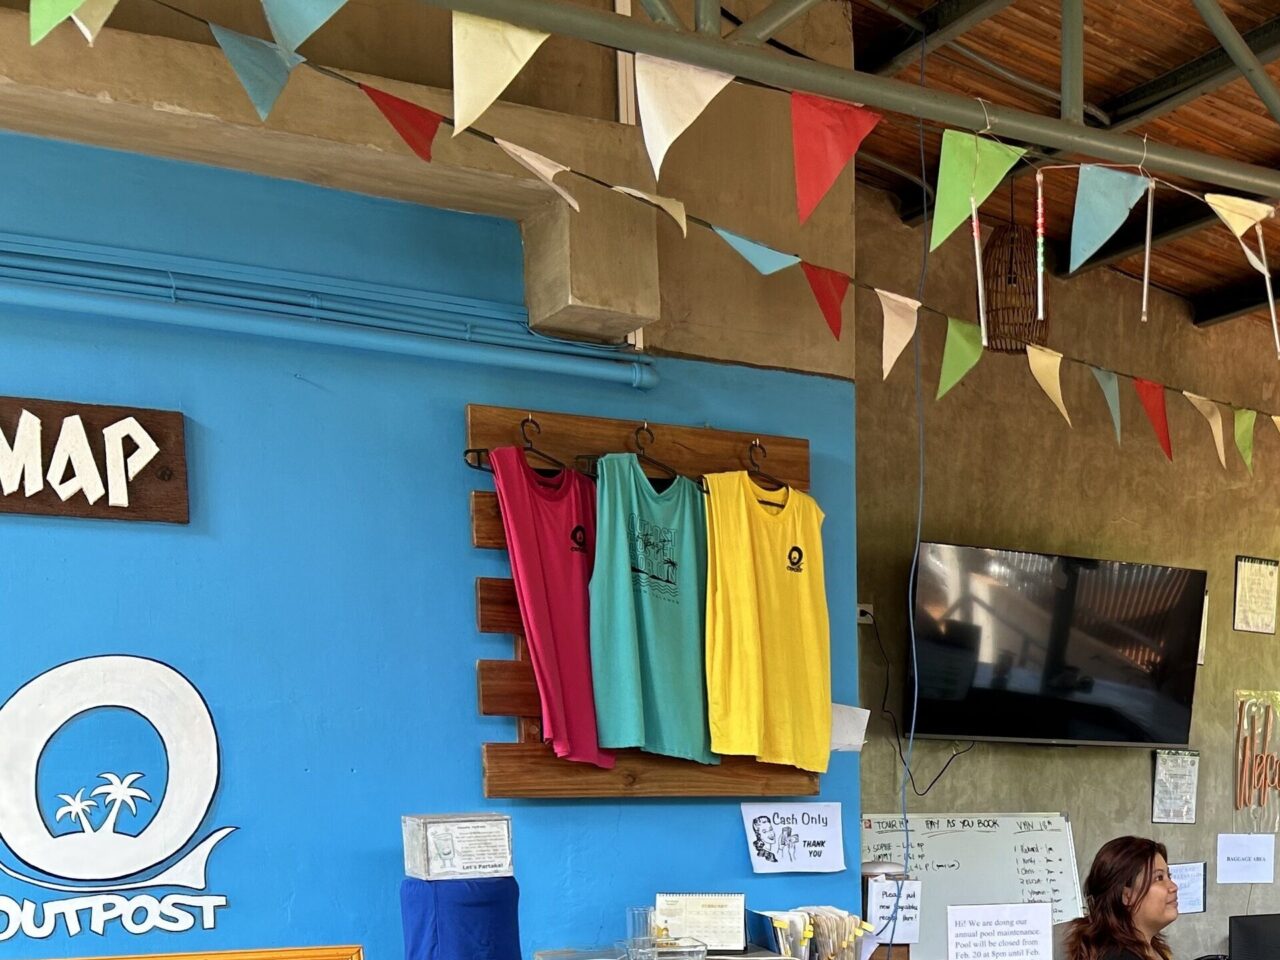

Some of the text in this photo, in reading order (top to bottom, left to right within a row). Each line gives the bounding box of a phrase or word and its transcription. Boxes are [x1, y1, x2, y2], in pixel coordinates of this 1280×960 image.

[772, 812, 828, 827] Cash Only
[977, 819, 999, 829] BOOK
[803, 840, 826, 848] THANK
[809, 850, 822, 858] YOU
[995, 919, 1014, 928] doing
[980, 930, 995, 939] pool
[992, 951, 1006, 960] 8pm
